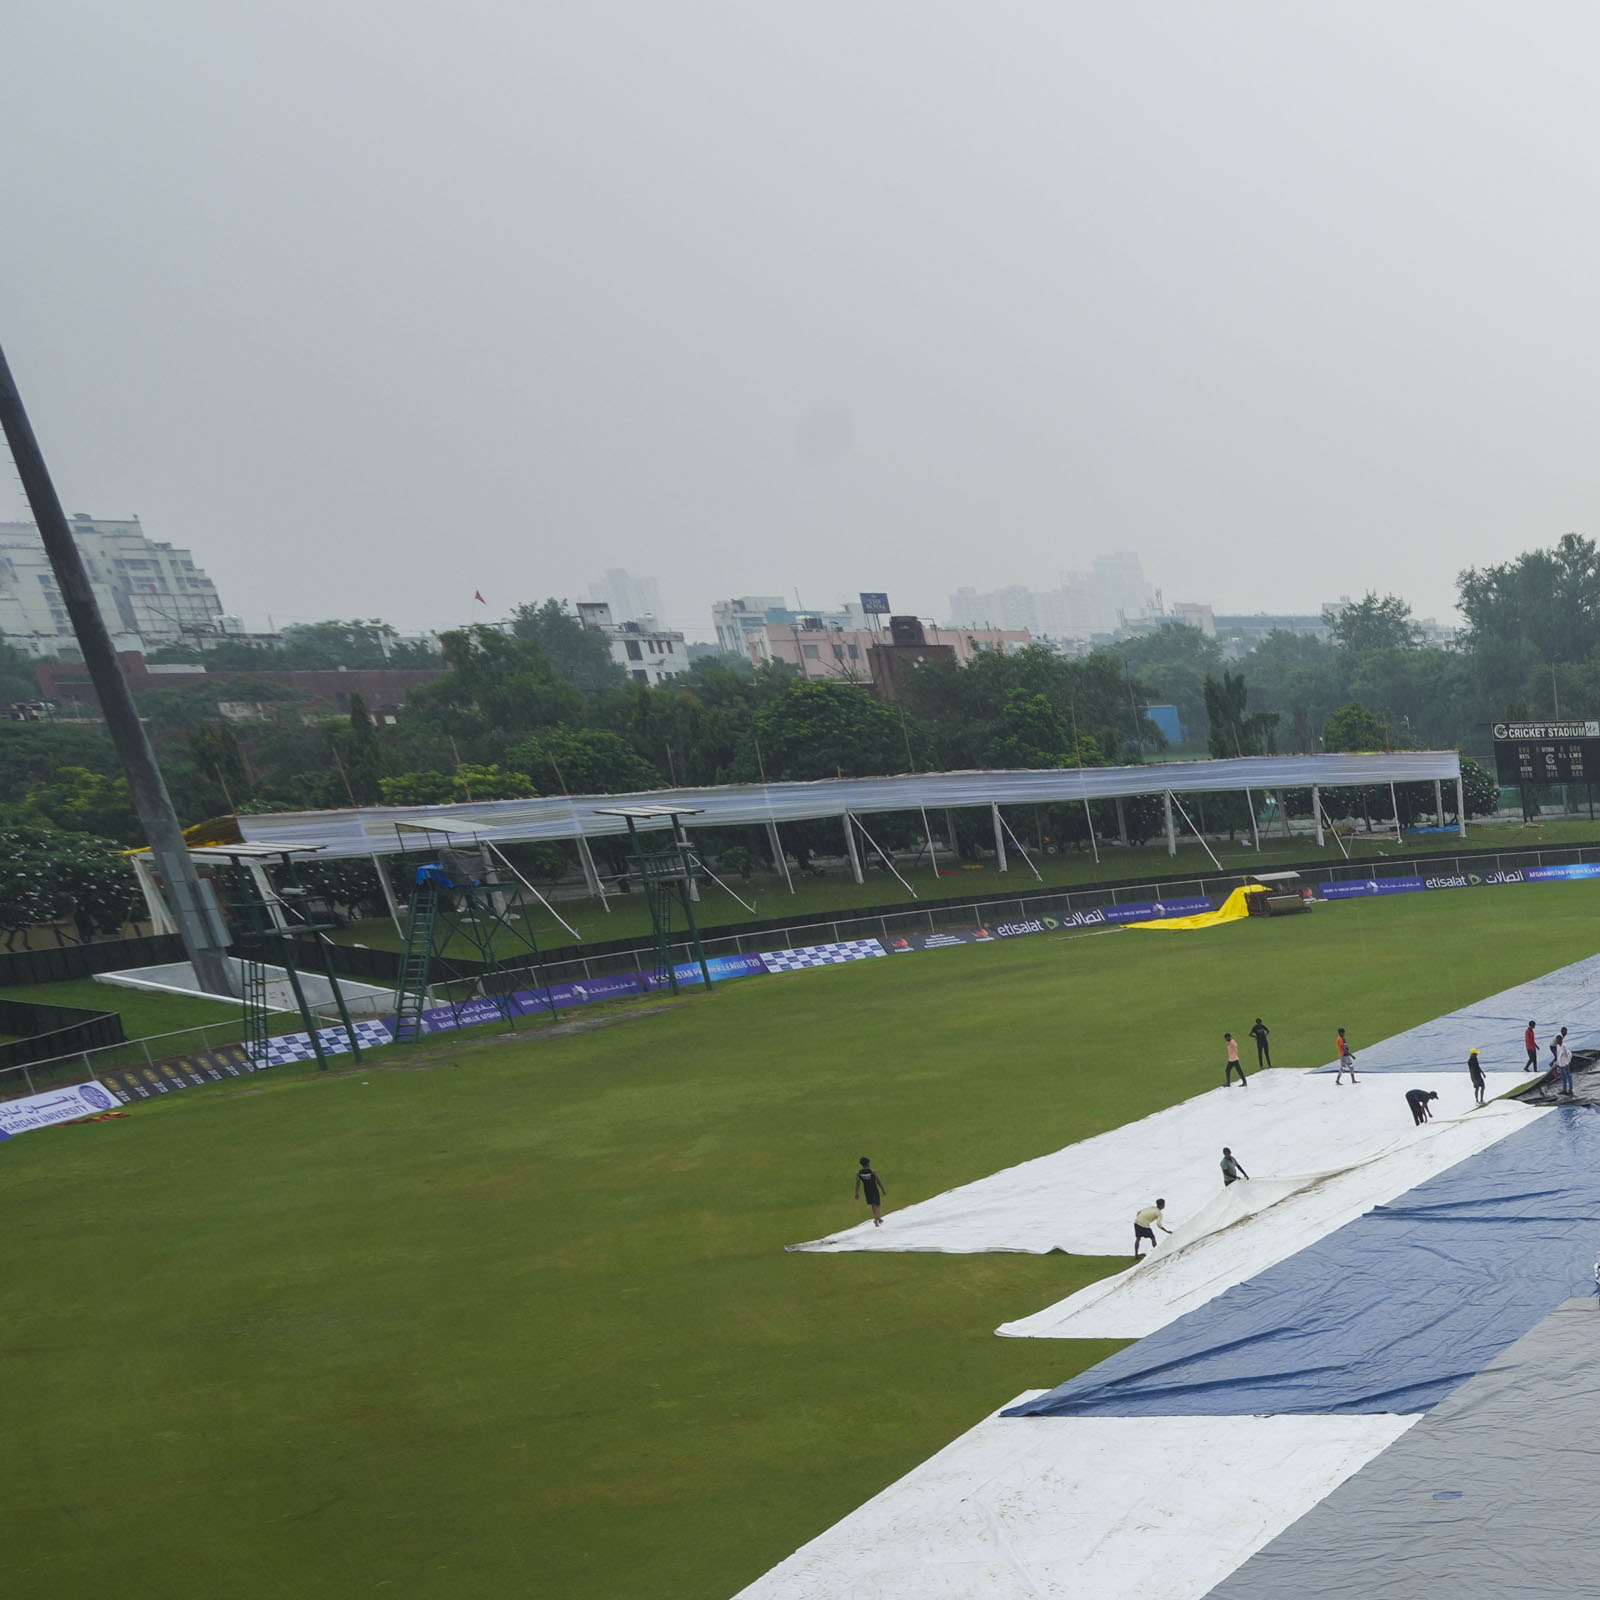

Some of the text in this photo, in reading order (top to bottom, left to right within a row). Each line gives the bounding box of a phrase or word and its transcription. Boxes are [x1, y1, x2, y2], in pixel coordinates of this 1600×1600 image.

[1508, 727, 1586, 738] CRICKET STADIUM
[1425, 875, 1467, 888] etisalat
[997, 919, 1045, 937] etisalat
[723, 960, 747, 972] LEAGUE
[747, 958, 760, 968] T20
[1, 1104, 88, 1131] KARDAN UNIVERSITY
